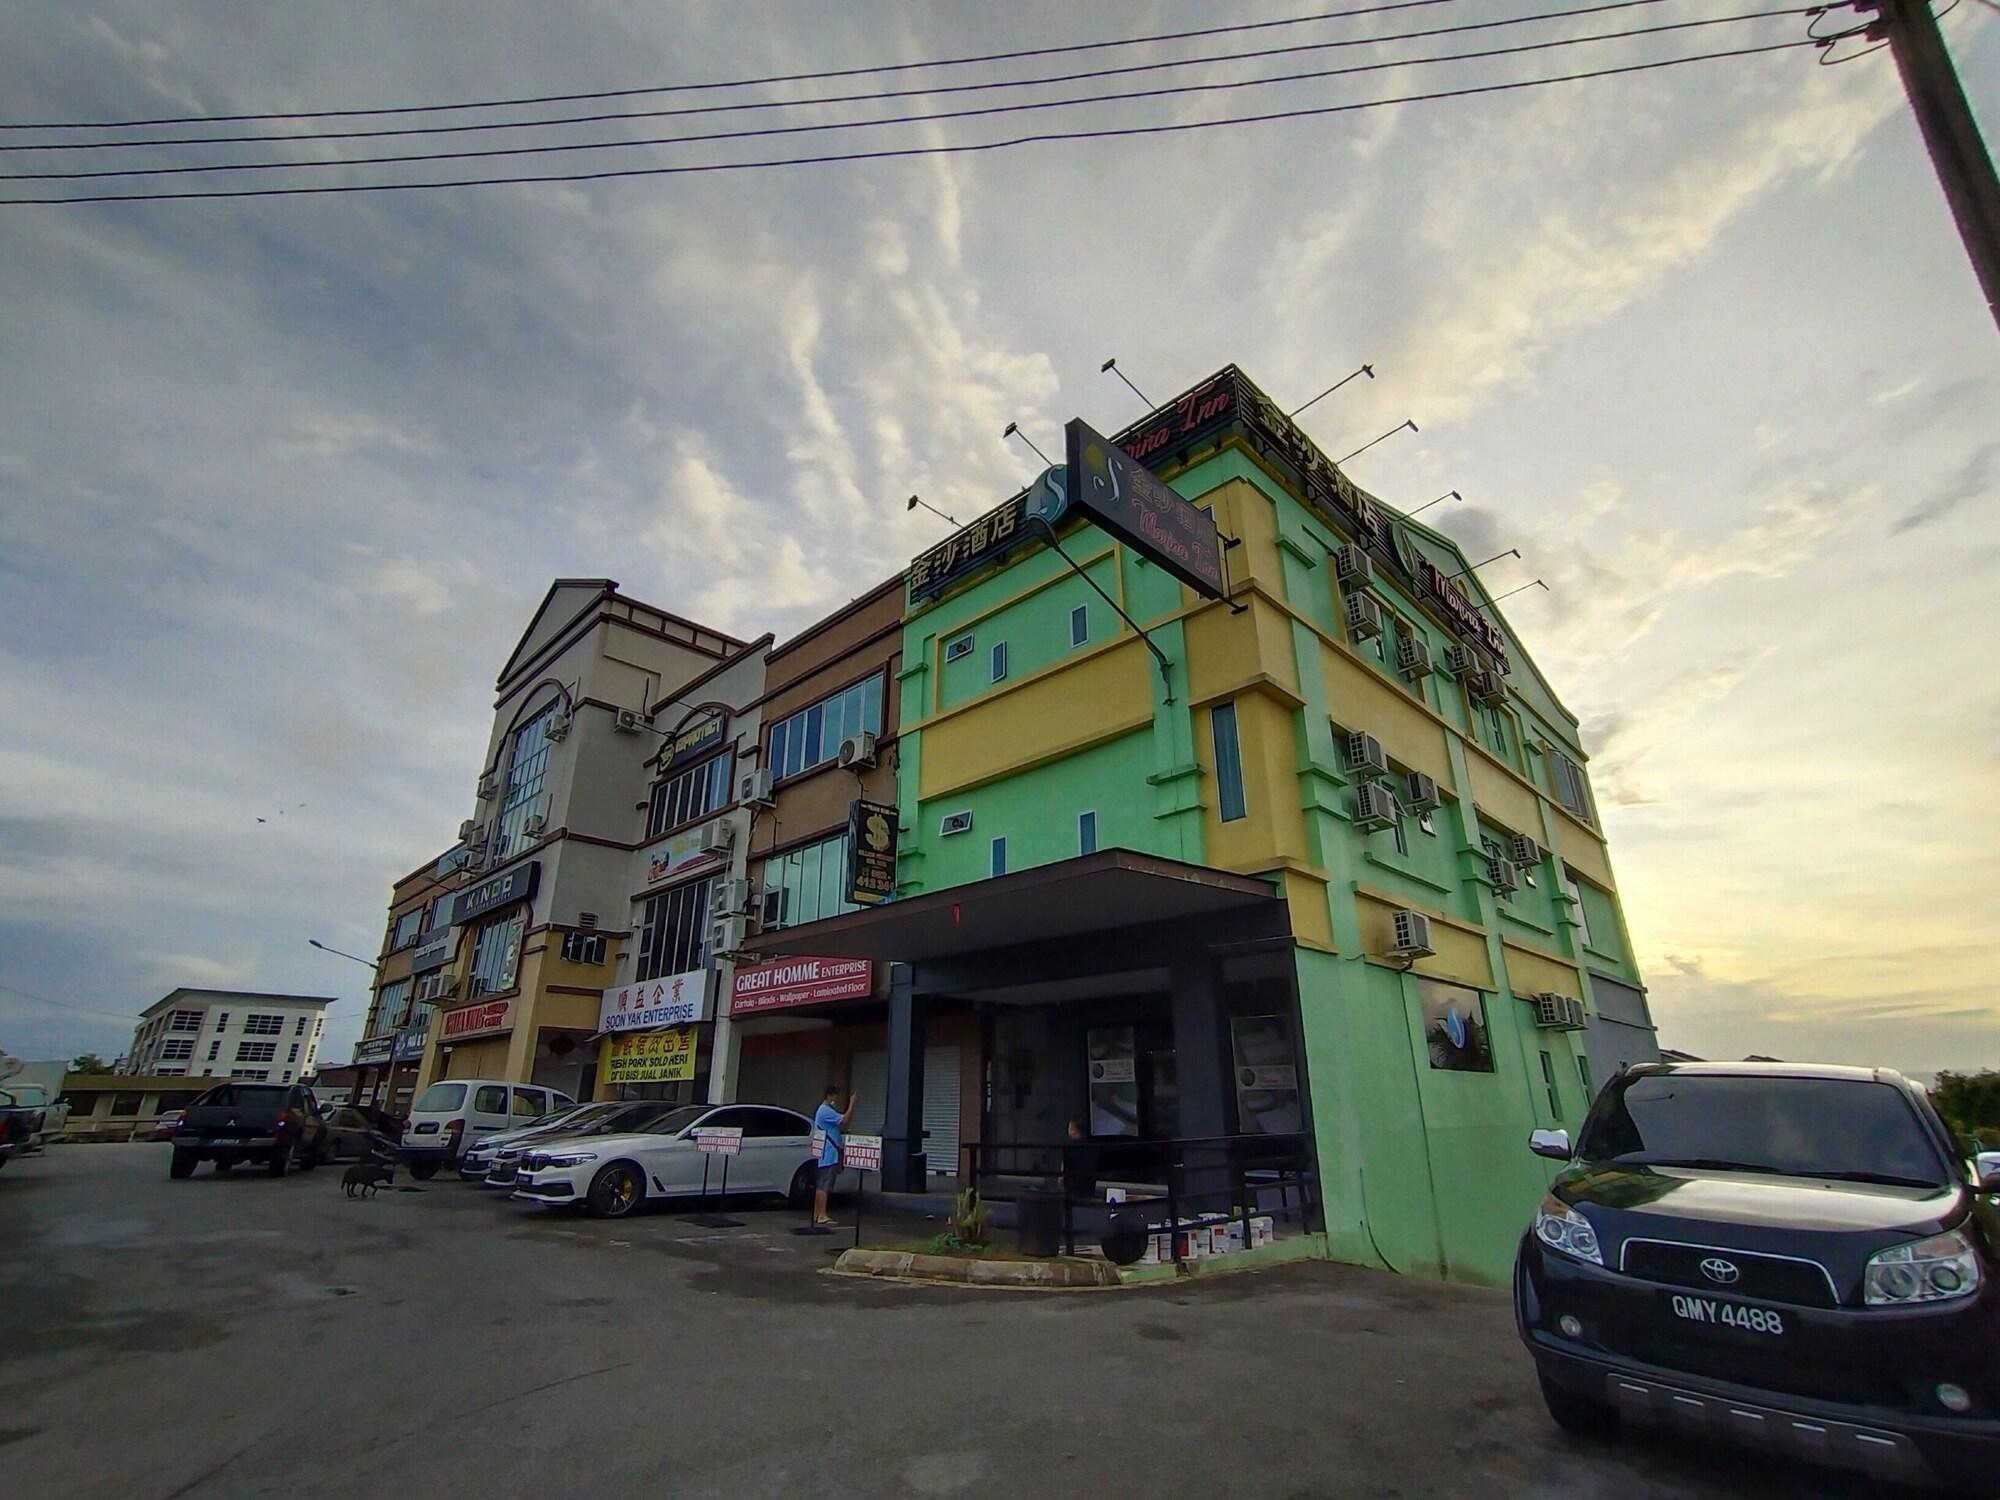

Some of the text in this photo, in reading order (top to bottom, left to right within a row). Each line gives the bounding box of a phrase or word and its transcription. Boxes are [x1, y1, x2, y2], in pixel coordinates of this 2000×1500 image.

[1177, 383, 1230, 431] Inn
[911, 504, 1017, 591] 金沙酒店
[736, 959, 868, 992] GREAT HOMME ENTERPRISE
[780, 991, 810, 1003] Wallpaper
[813, 984, 848, 997] Laminated
[848, 982, 866, 993] Floor
[605, 1003, 694, 1028] SOON YAK ENTERPRISE
[628, 1057, 648, 1068] PORK
[649, 1055, 668, 1067] SOLD
[698, 1137, 718, 1145] RESERVE
[845, 1146, 881, 1159] RESERVED
[845, 1156, 879, 1168] PARKING
[1671, 1295, 1784, 1335] QMY 4488
